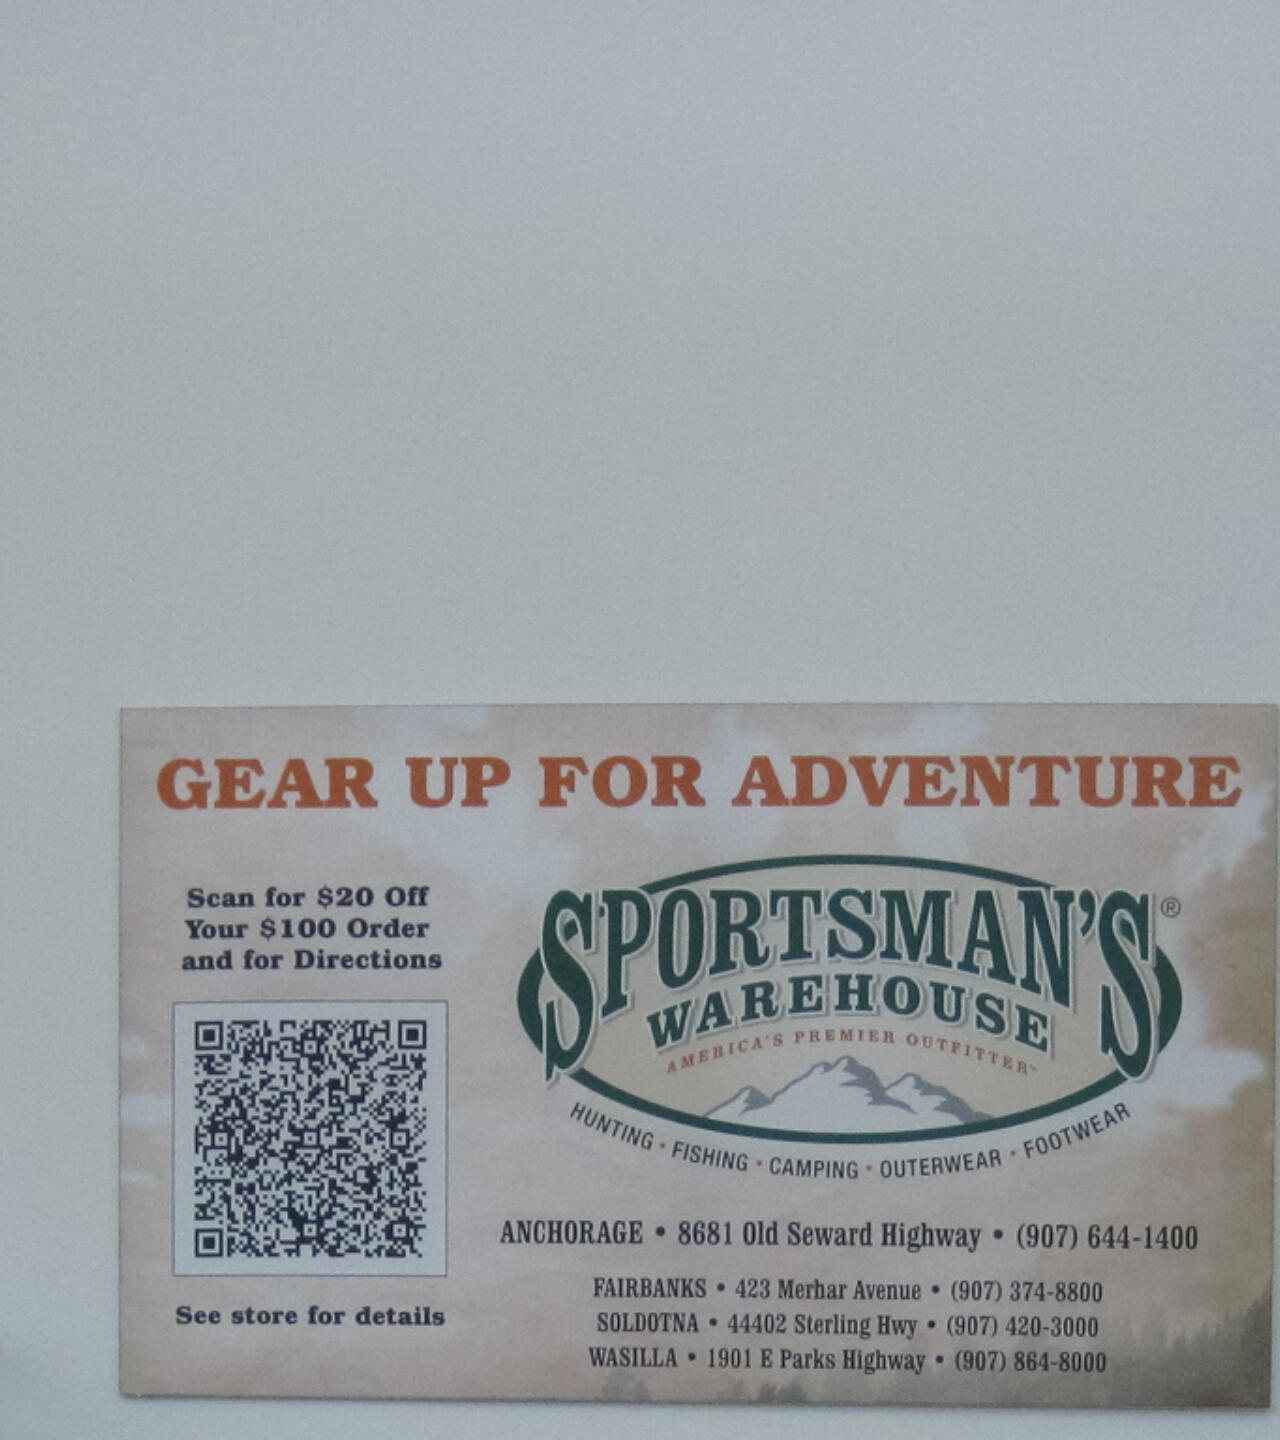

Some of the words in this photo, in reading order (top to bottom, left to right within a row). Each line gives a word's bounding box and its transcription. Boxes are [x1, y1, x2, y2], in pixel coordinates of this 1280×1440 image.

[156, 757, 379, 810] GEAR
[405, 756, 511, 808] UP
[538, 755, 706, 808] FOR
[731, 755, 1243, 808] ADVENTURE
[187, 888, 255, 908] Scan
[265, 886, 305, 907] for
[317, 885, 374, 909] $20
[385, 886, 429, 907] Off
[184, 919, 248, 939] Your
[260, 916, 336, 941] $100
[347, 917, 429, 938] Order
[182, 950, 233, 971] and
[243, 949, 283, 970] for
[294, 949, 442, 970] Directions
[541, 887, 1154, 1083] SPORTSMAN'S
[646, 973, 1049, 1052] WAREHOUSE
[666, 1030, 783, 1074] AMERICA'S
[794, 1028, 896, 1044] PREMIER
[570, 1101, 655, 1150] HUNTING
[671, 1140, 748, 1172] FISHING
[770, 1156, 859, 1180] CAMPING
[880, 1149, 1003, 1178] OUTERWEAR
[1023, 1102, 1131, 1159] FOOTWEAR
[500, 1220, 643, 1244] ANCHORAGE
[678, 1221, 732, 1246] 8681
[743, 1221, 778, 1246] Old
[787, 1222, 872, 1246] Seward
[881, 1222, 982, 1252] Highway
[1016, 1223, 1078, 1249] (907)
[1087, 1224, 1198, 1250] 644-1400
[593, 1277, 707, 1298] FAIRBANKS
[735, 1278, 770, 1299] 423
[778, 1279, 847, 1299] Merhar
[853, 1280, 921, 1300] Avenue
[950, 1280, 1002, 1302] (907)
[1010, 1281, 1103, 1302] 374-8800
[175, 1306, 221, 1325] See
[231, 1306, 298, 1325] store
[307, 1305, 345, 1325] for
[355, 1306, 445, 1326] details
[597, 1312, 699, 1333] SOLDOTNA
[727, 1314, 786, 1334] 44402
[794, 1314, 871, 1339] Sterling
[877, 1315, 918, 1339] Hwy
[946, 1315, 998, 1338] (907)
[1005, 1316, 1099, 1338] 420-3000
[588, 1347, 677, 1368] WASILLA
[707, 1348, 752, 1368] 1901
[761, 1348, 772, 1368] E
[780, 1349, 836, 1369] Parks
[842, 1349, 926, 1374] Highway
[954, 1351, 1006, 1372] (907)
[1014, 1352, 1107, 1373] 864-8000
